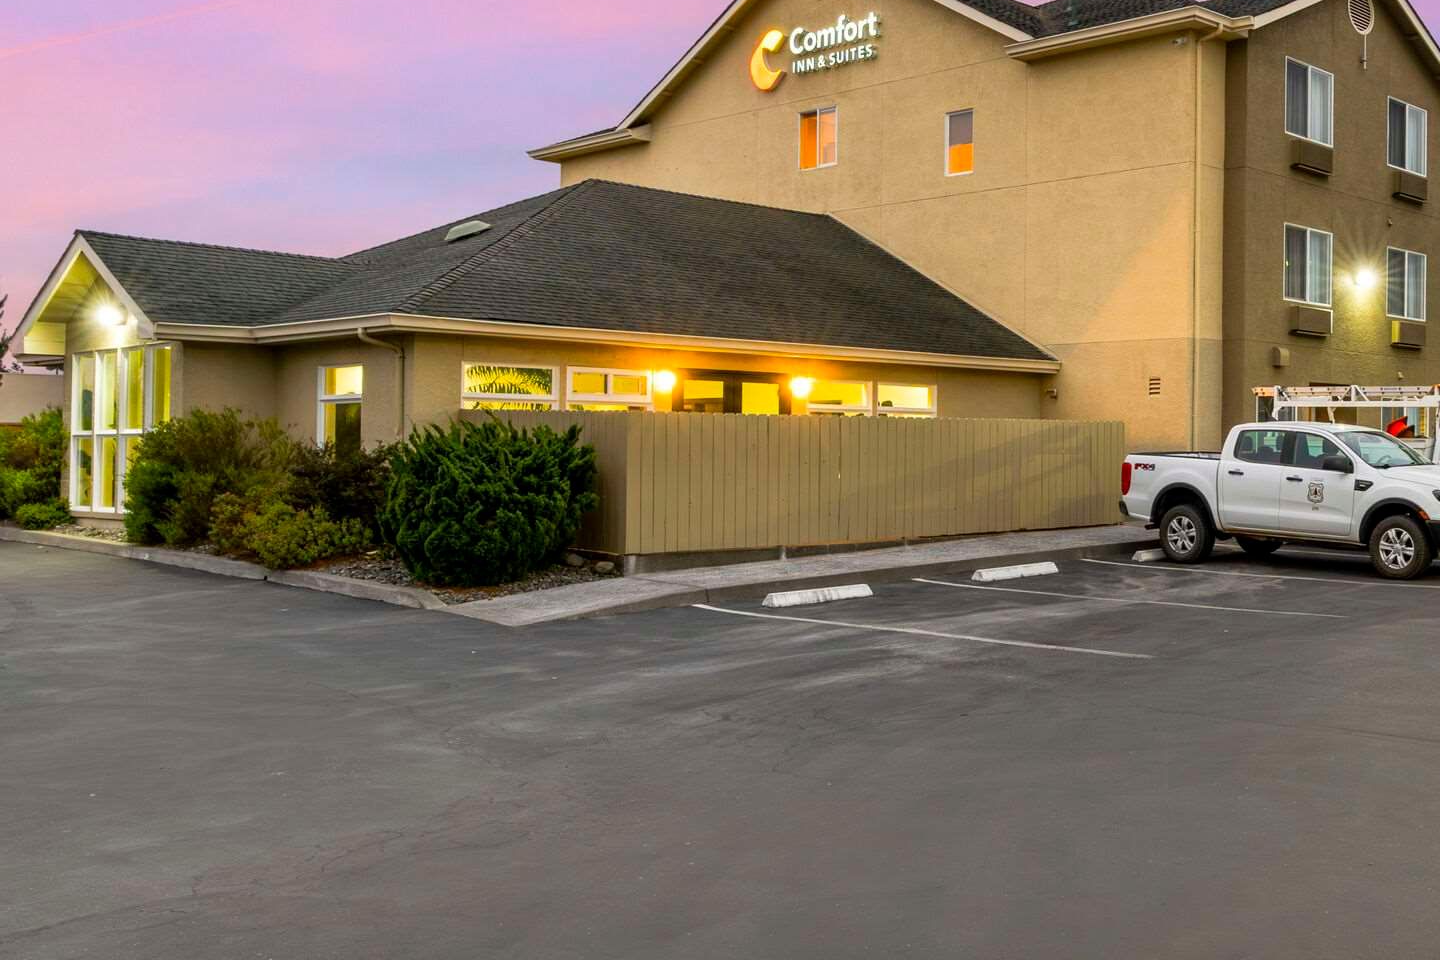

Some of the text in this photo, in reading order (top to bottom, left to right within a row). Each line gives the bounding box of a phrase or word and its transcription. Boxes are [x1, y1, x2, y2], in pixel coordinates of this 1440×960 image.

[789, 11, 878, 54] Comfort
[792, 44, 873, 74] INN & SUITES
